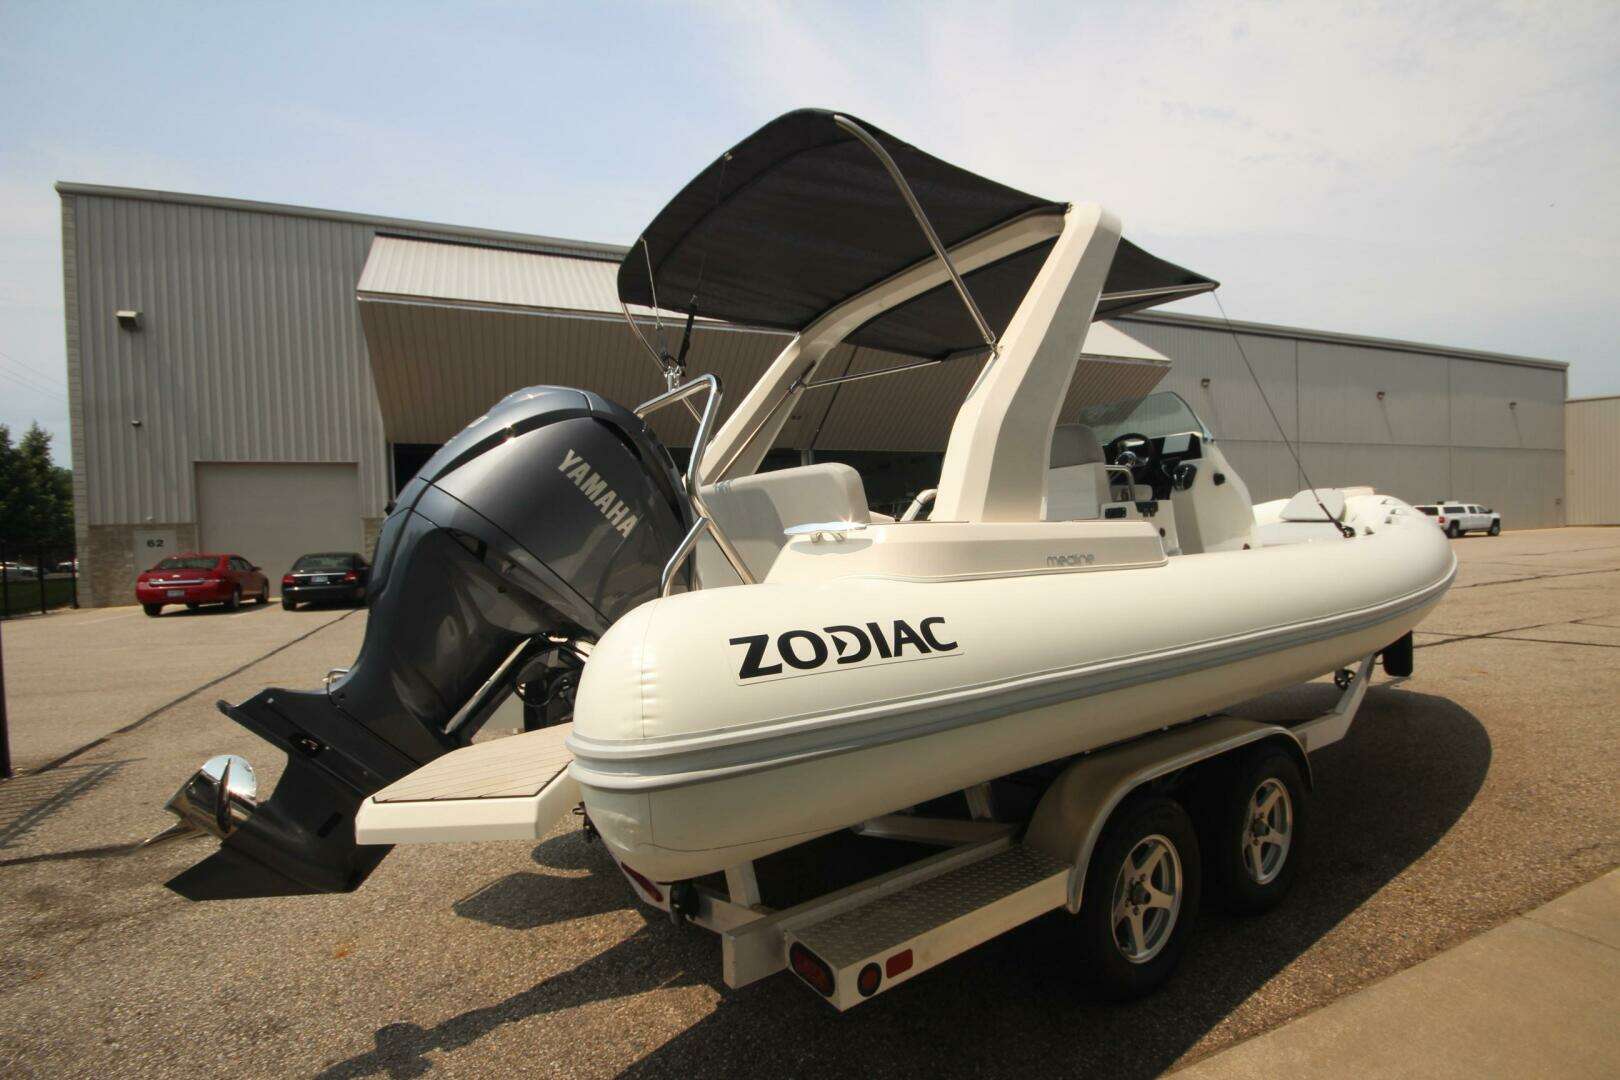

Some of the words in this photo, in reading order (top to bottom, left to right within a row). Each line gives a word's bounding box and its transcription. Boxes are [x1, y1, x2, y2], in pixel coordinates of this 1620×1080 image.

[558, 449, 638, 538] YAMAHA
[146, 539, 164, 548] 62
[729, 616, 958, 679] ZODIAC
